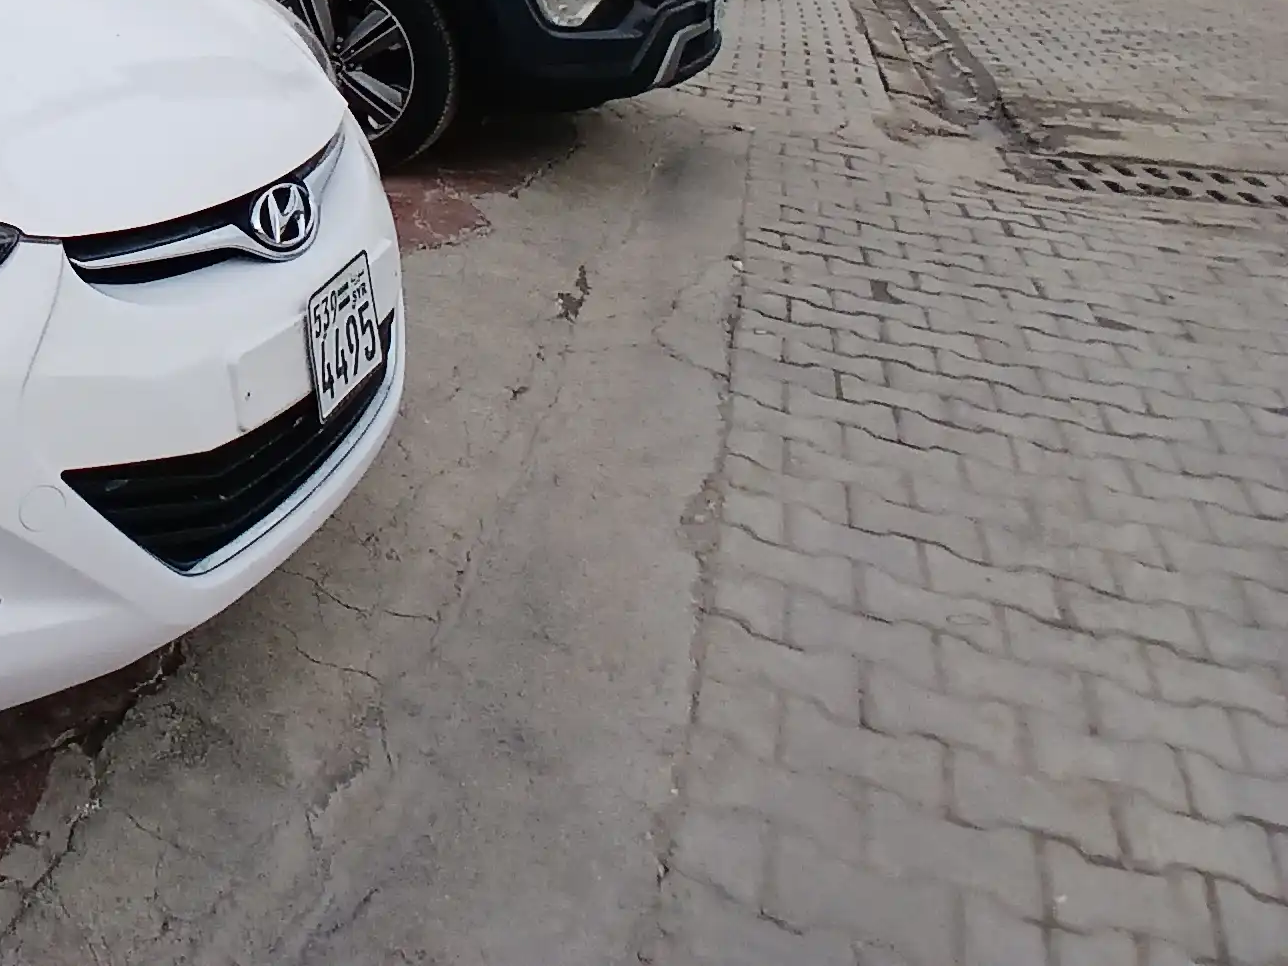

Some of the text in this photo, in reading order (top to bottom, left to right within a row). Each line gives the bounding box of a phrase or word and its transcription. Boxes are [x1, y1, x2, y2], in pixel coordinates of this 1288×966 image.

[313, 290, 338, 340] 539
[352, 282, 367, 300] SYR
[321, 300, 376, 400] 4495
